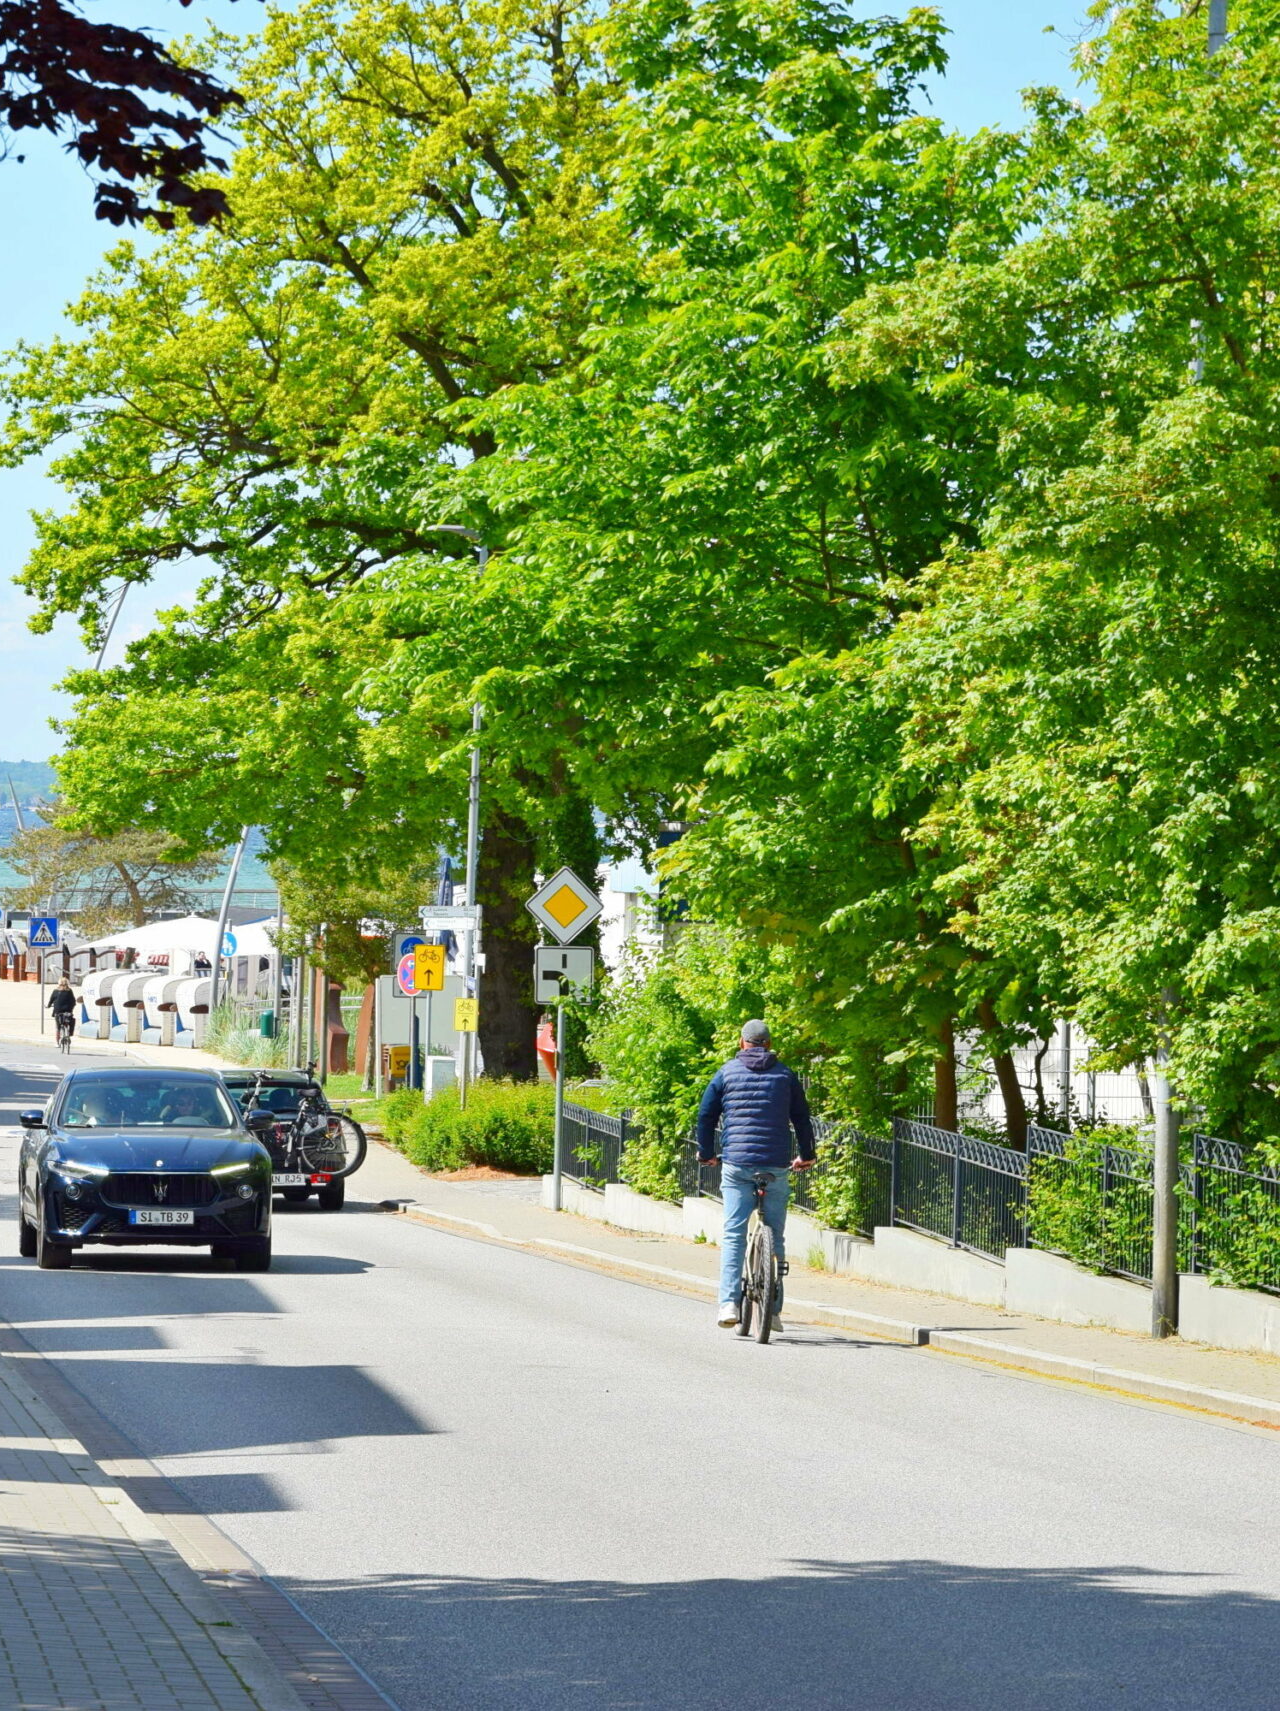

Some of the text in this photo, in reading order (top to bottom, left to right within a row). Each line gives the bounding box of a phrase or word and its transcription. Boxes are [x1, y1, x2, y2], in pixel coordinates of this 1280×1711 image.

[140, 1211, 189, 1223] SI TB 39
